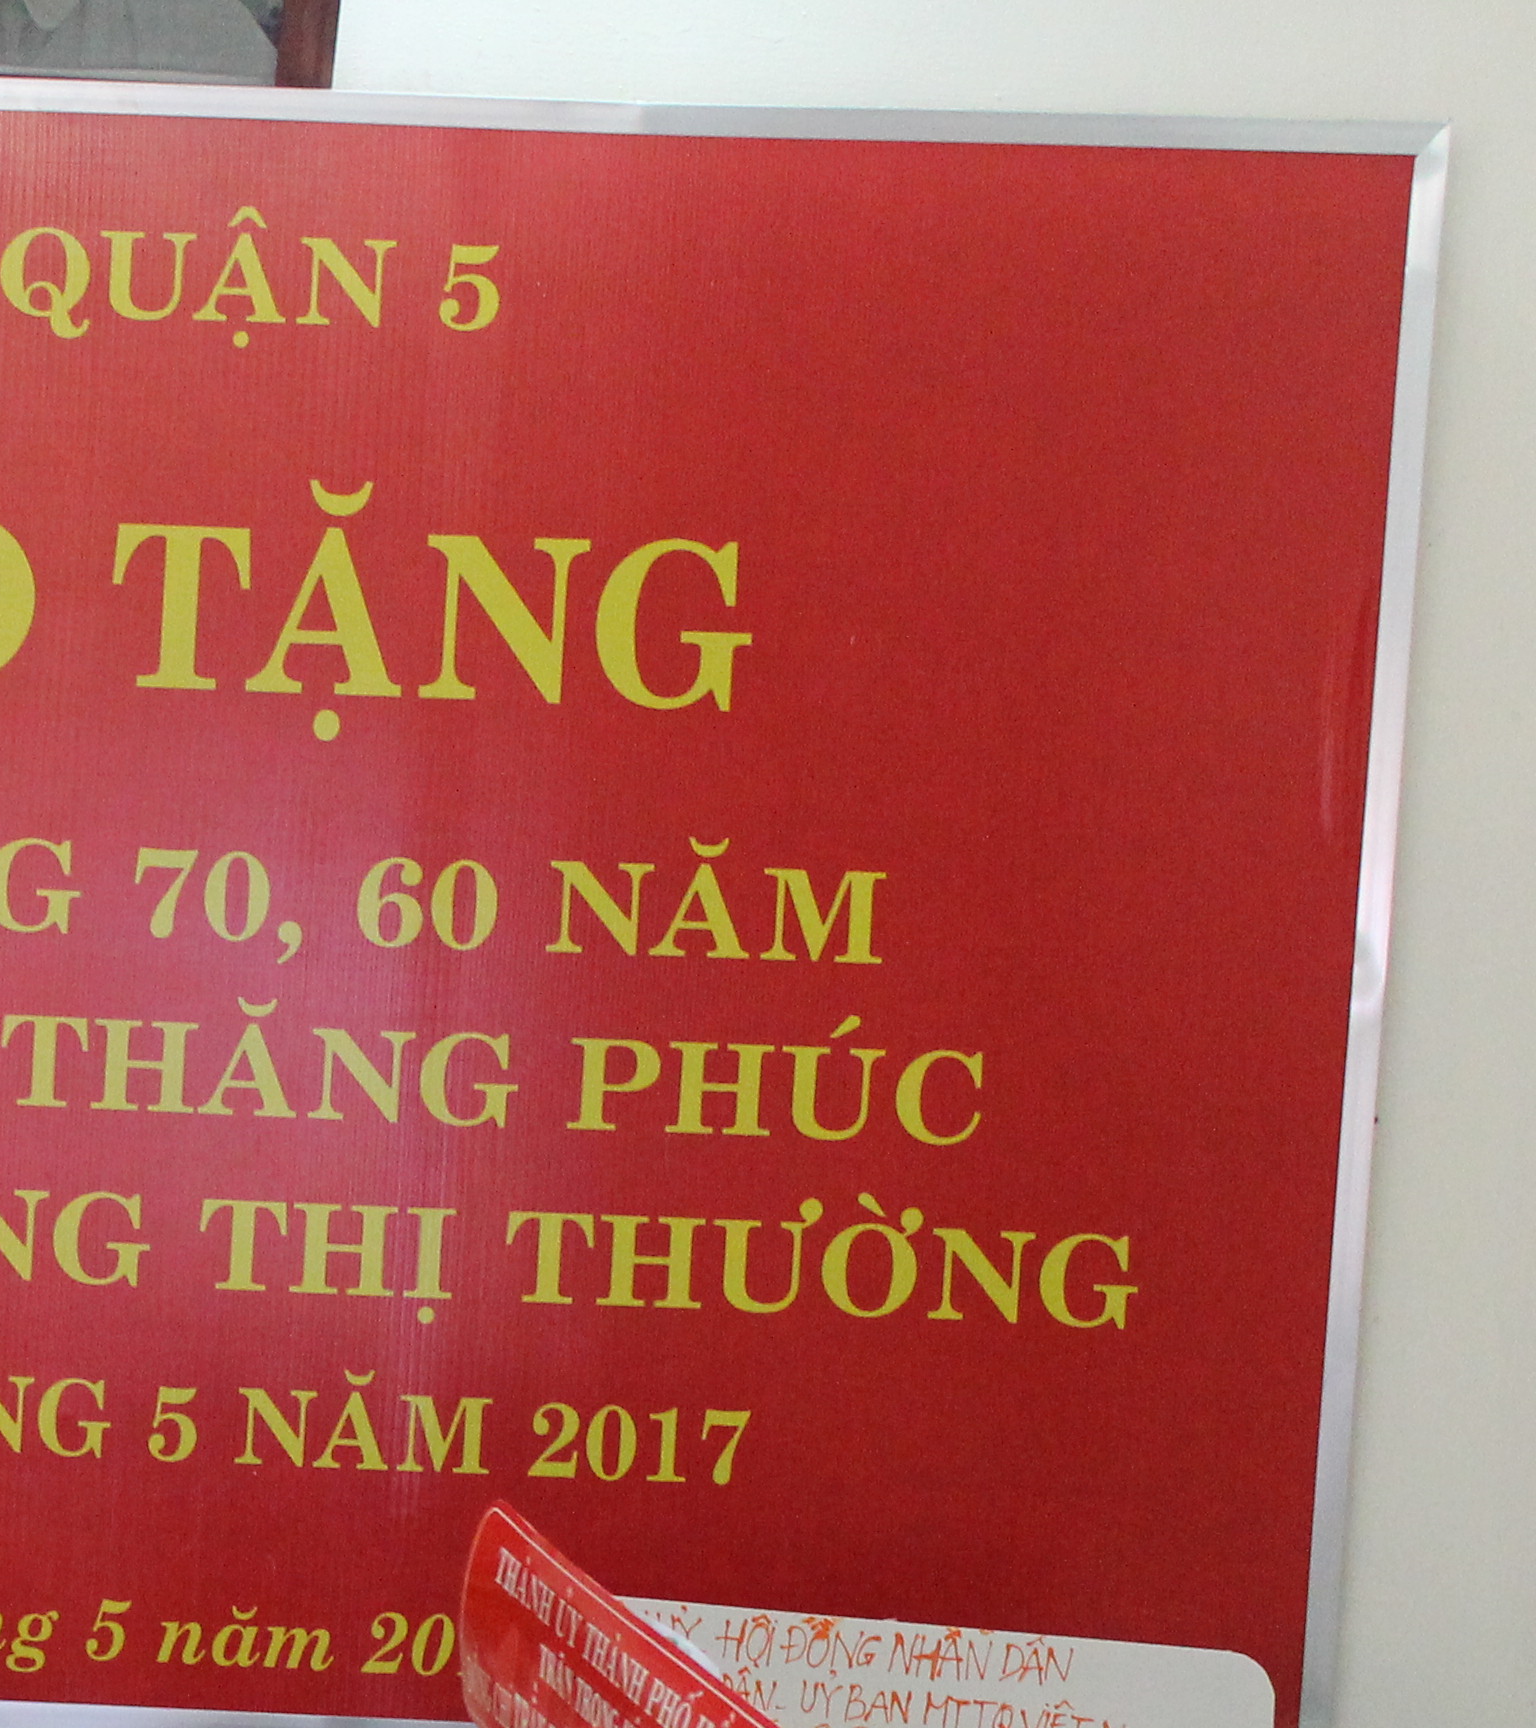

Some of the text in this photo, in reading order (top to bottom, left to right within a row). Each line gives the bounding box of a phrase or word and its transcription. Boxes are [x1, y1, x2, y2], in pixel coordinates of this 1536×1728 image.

[0, 207, 397, 347] QUẬN
[439, 245, 500, 331] 5
[113, 480, 752, 740] TẶNG
[138, 848, 301, 963] 70,
[360, 858, 498, 949] 60
[547, 838, 886, 963] NĂM
[3, 1004, 518, 1126] THĂNG
[567, 1016, 982, 1145] PHÚC
[202, 1200, 456, 1322] THỊ
[508, 1193, 1138, 1329] THƯỜNG
[149, 1387, 197, 1462] 5
[235, 1372, 492, 1473] NĂM
[528, 1403, 750, 1484] 2017
[85, 1599, 132, 1662] 5
[155, 1605, 334, 1672] năm
[360, 1611, 462, 1677] 20
[845, 1683, 912, 1724] BAN
